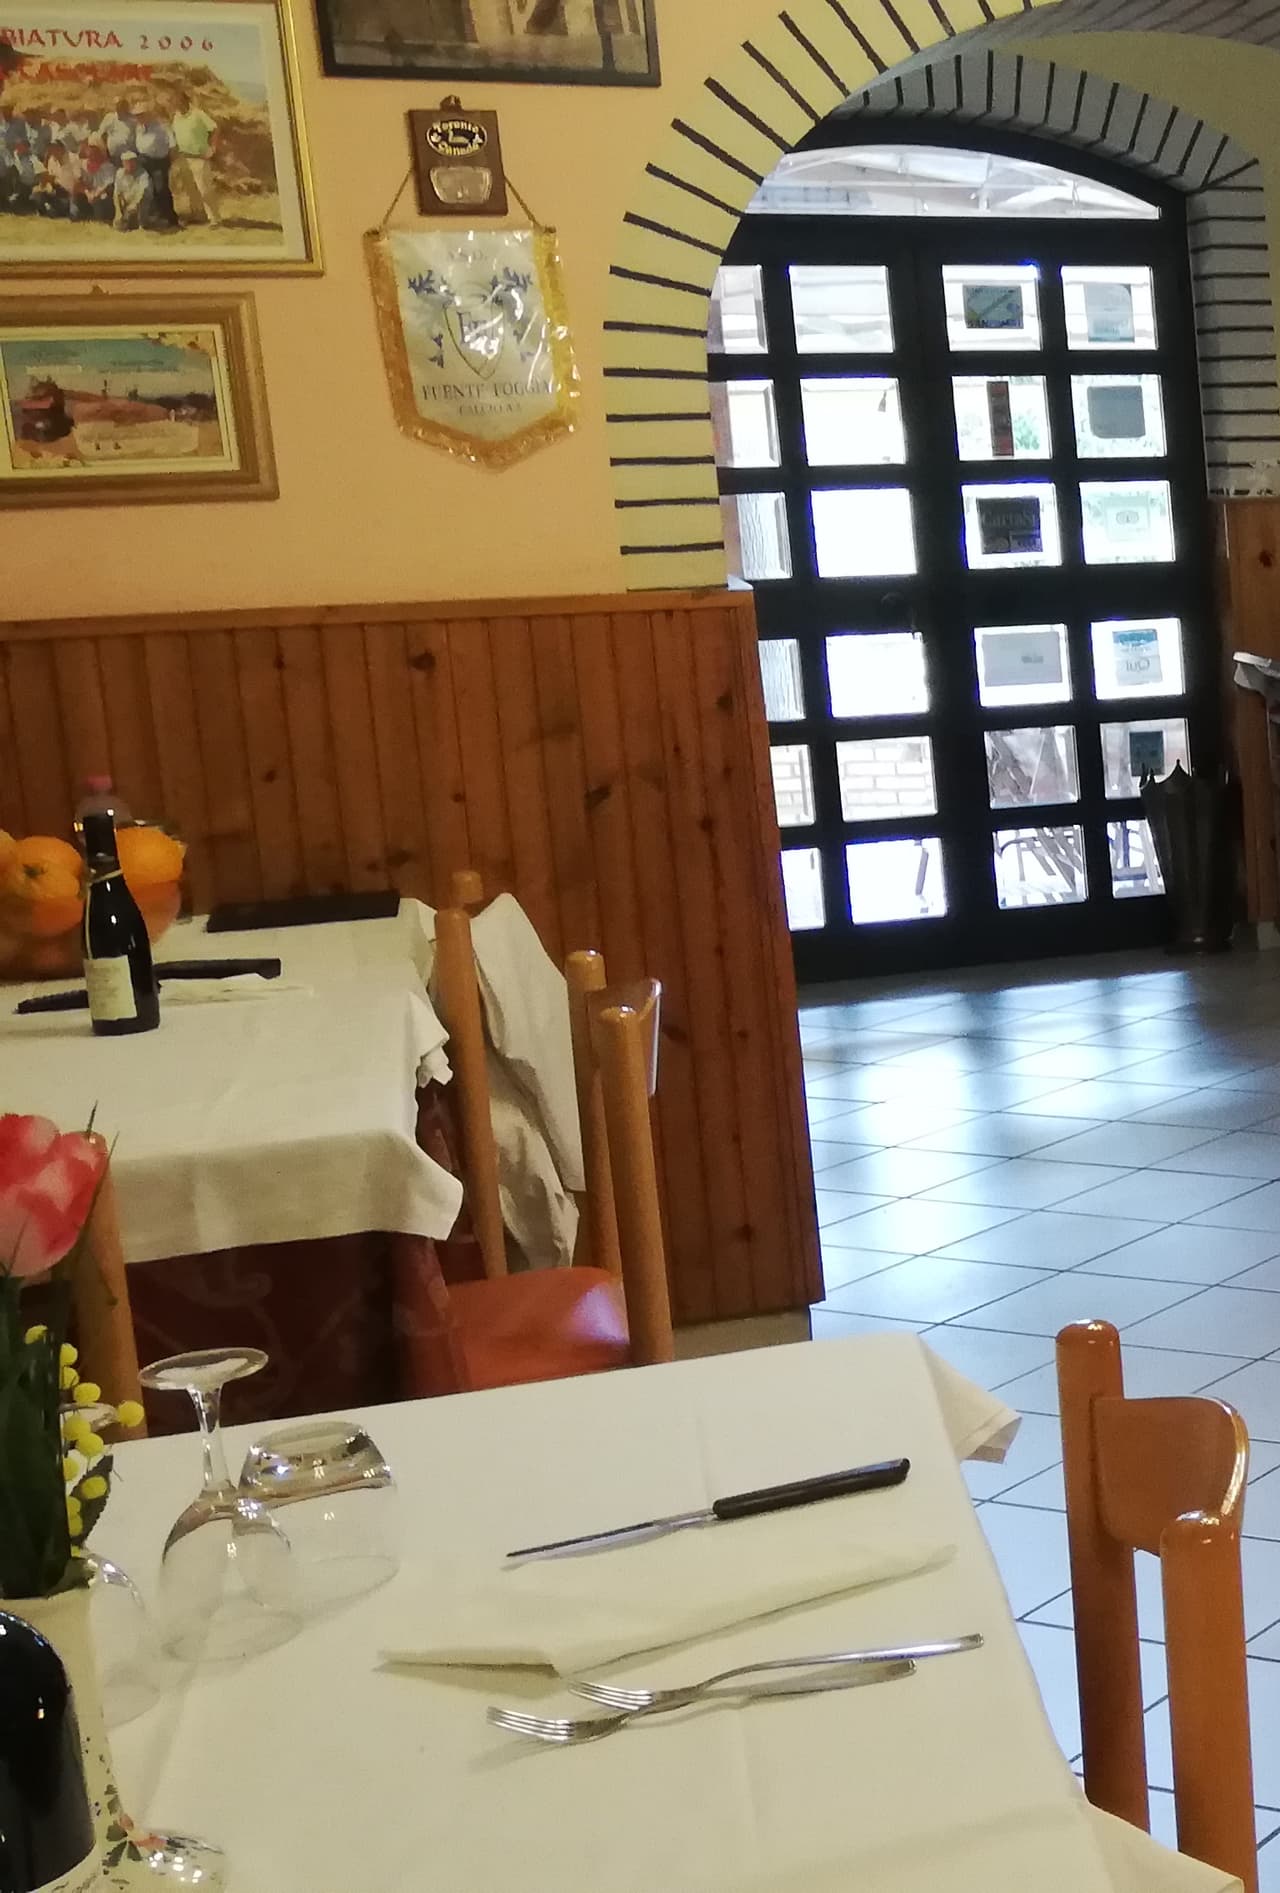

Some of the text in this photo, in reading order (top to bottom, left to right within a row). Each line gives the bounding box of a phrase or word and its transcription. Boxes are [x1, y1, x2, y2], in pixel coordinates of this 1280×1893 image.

[139, 34, 214, 51] 2006
[432, 121, 480, 134] Toronto
[438, 141, 480, 156] Canada
